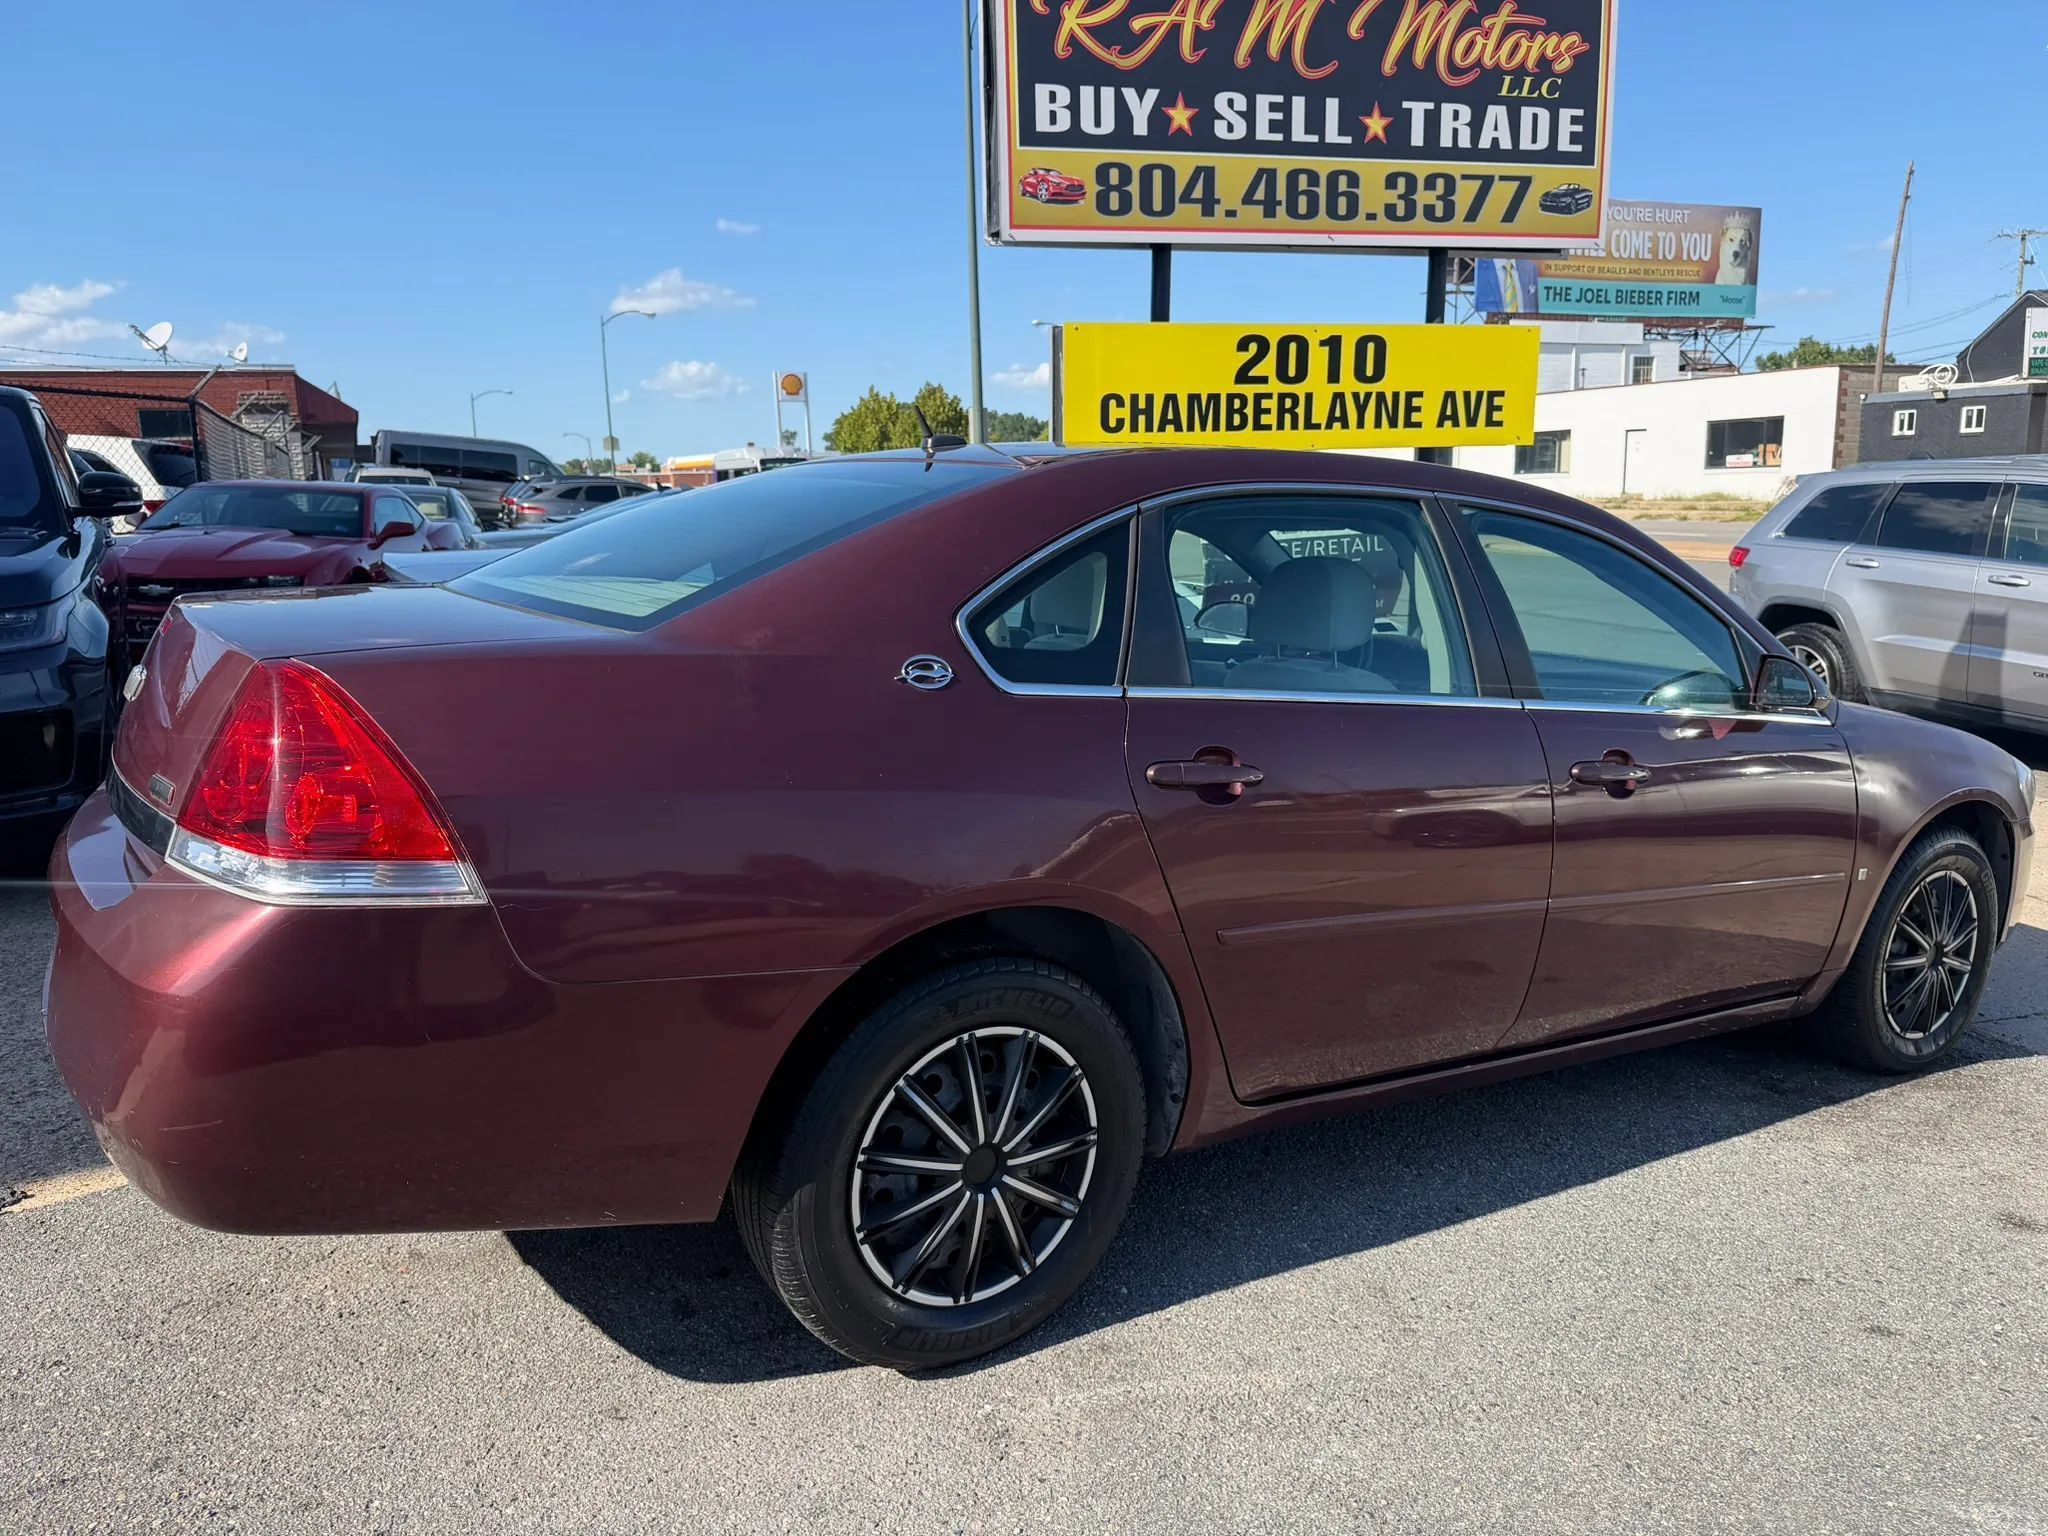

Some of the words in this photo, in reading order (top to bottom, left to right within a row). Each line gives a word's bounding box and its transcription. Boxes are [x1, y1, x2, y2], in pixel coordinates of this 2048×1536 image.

[1348, 0, 1590, 86] Motors
[1498, 75, 1562, 99] LLC
[1034, 82, 1161, 137] BUY
[1213, 90, 1354, 146] SELL
[1402, 100, 1585, 153] TRADE
[1094, 161, 1534, 224] 804.466.3377
[1606, 206, 1652, 224] YOU'RE
[1655, 208, 1691, 225] HURT
[1610, 228, 1654, 260] COME
[1656, 231, 1677, 261] TO
[1680, 233, 1713, 262] YOU
[1544, 263, 1553, 271] IN
[1554, 264, 1585, 273] SUPPORT
[1587, 265, 1597, 273] OF
[1597, 266, 1627, 275] BEAGLES
[1629, 267, 1642, 276] AND
[1643, 268, 1676, 277] BENTLEYS
[1677, 269, 1701, 278] RESCUE
[1544, 286, 1573, 302] THE
[1575, 287, 1614, 304] JOEL
[1615, 289, 1664, 306] BIEBER
[1666, 291, 1700, 306] FIRM
[1234, 333, 1388, 385] 2010
[1100, 391, 1423, 434] CHAMBERLAYNE
[1436, 389, 1506, 428] AVE
[1280, 535, 1384, 559] E/RETAIL
